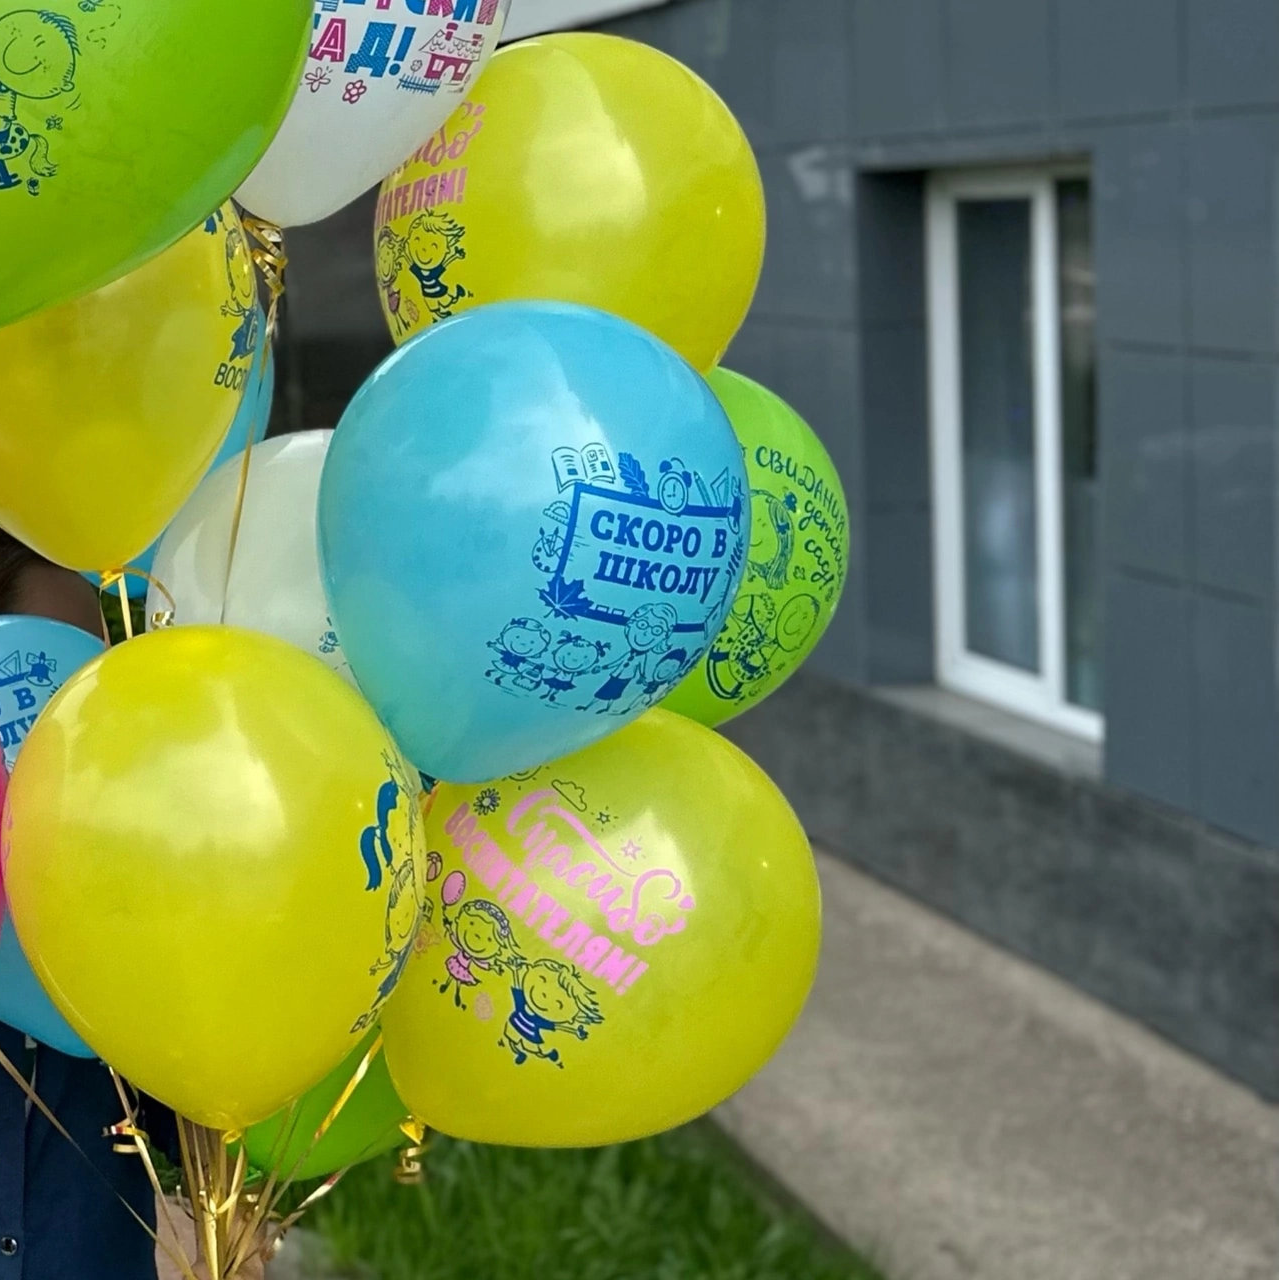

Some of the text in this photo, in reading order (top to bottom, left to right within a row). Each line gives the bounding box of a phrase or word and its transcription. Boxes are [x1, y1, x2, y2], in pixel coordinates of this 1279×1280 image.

[311, 14, 416, 78] АД!
[590, 510, 727, 558] СКОРО В
[593, 550, 721, 604] ШКОЛУ
[444, 802, 650, 996] ВОСПИТАТЕЛЯМ!
[506, 789, 688, 947] Спасибо
